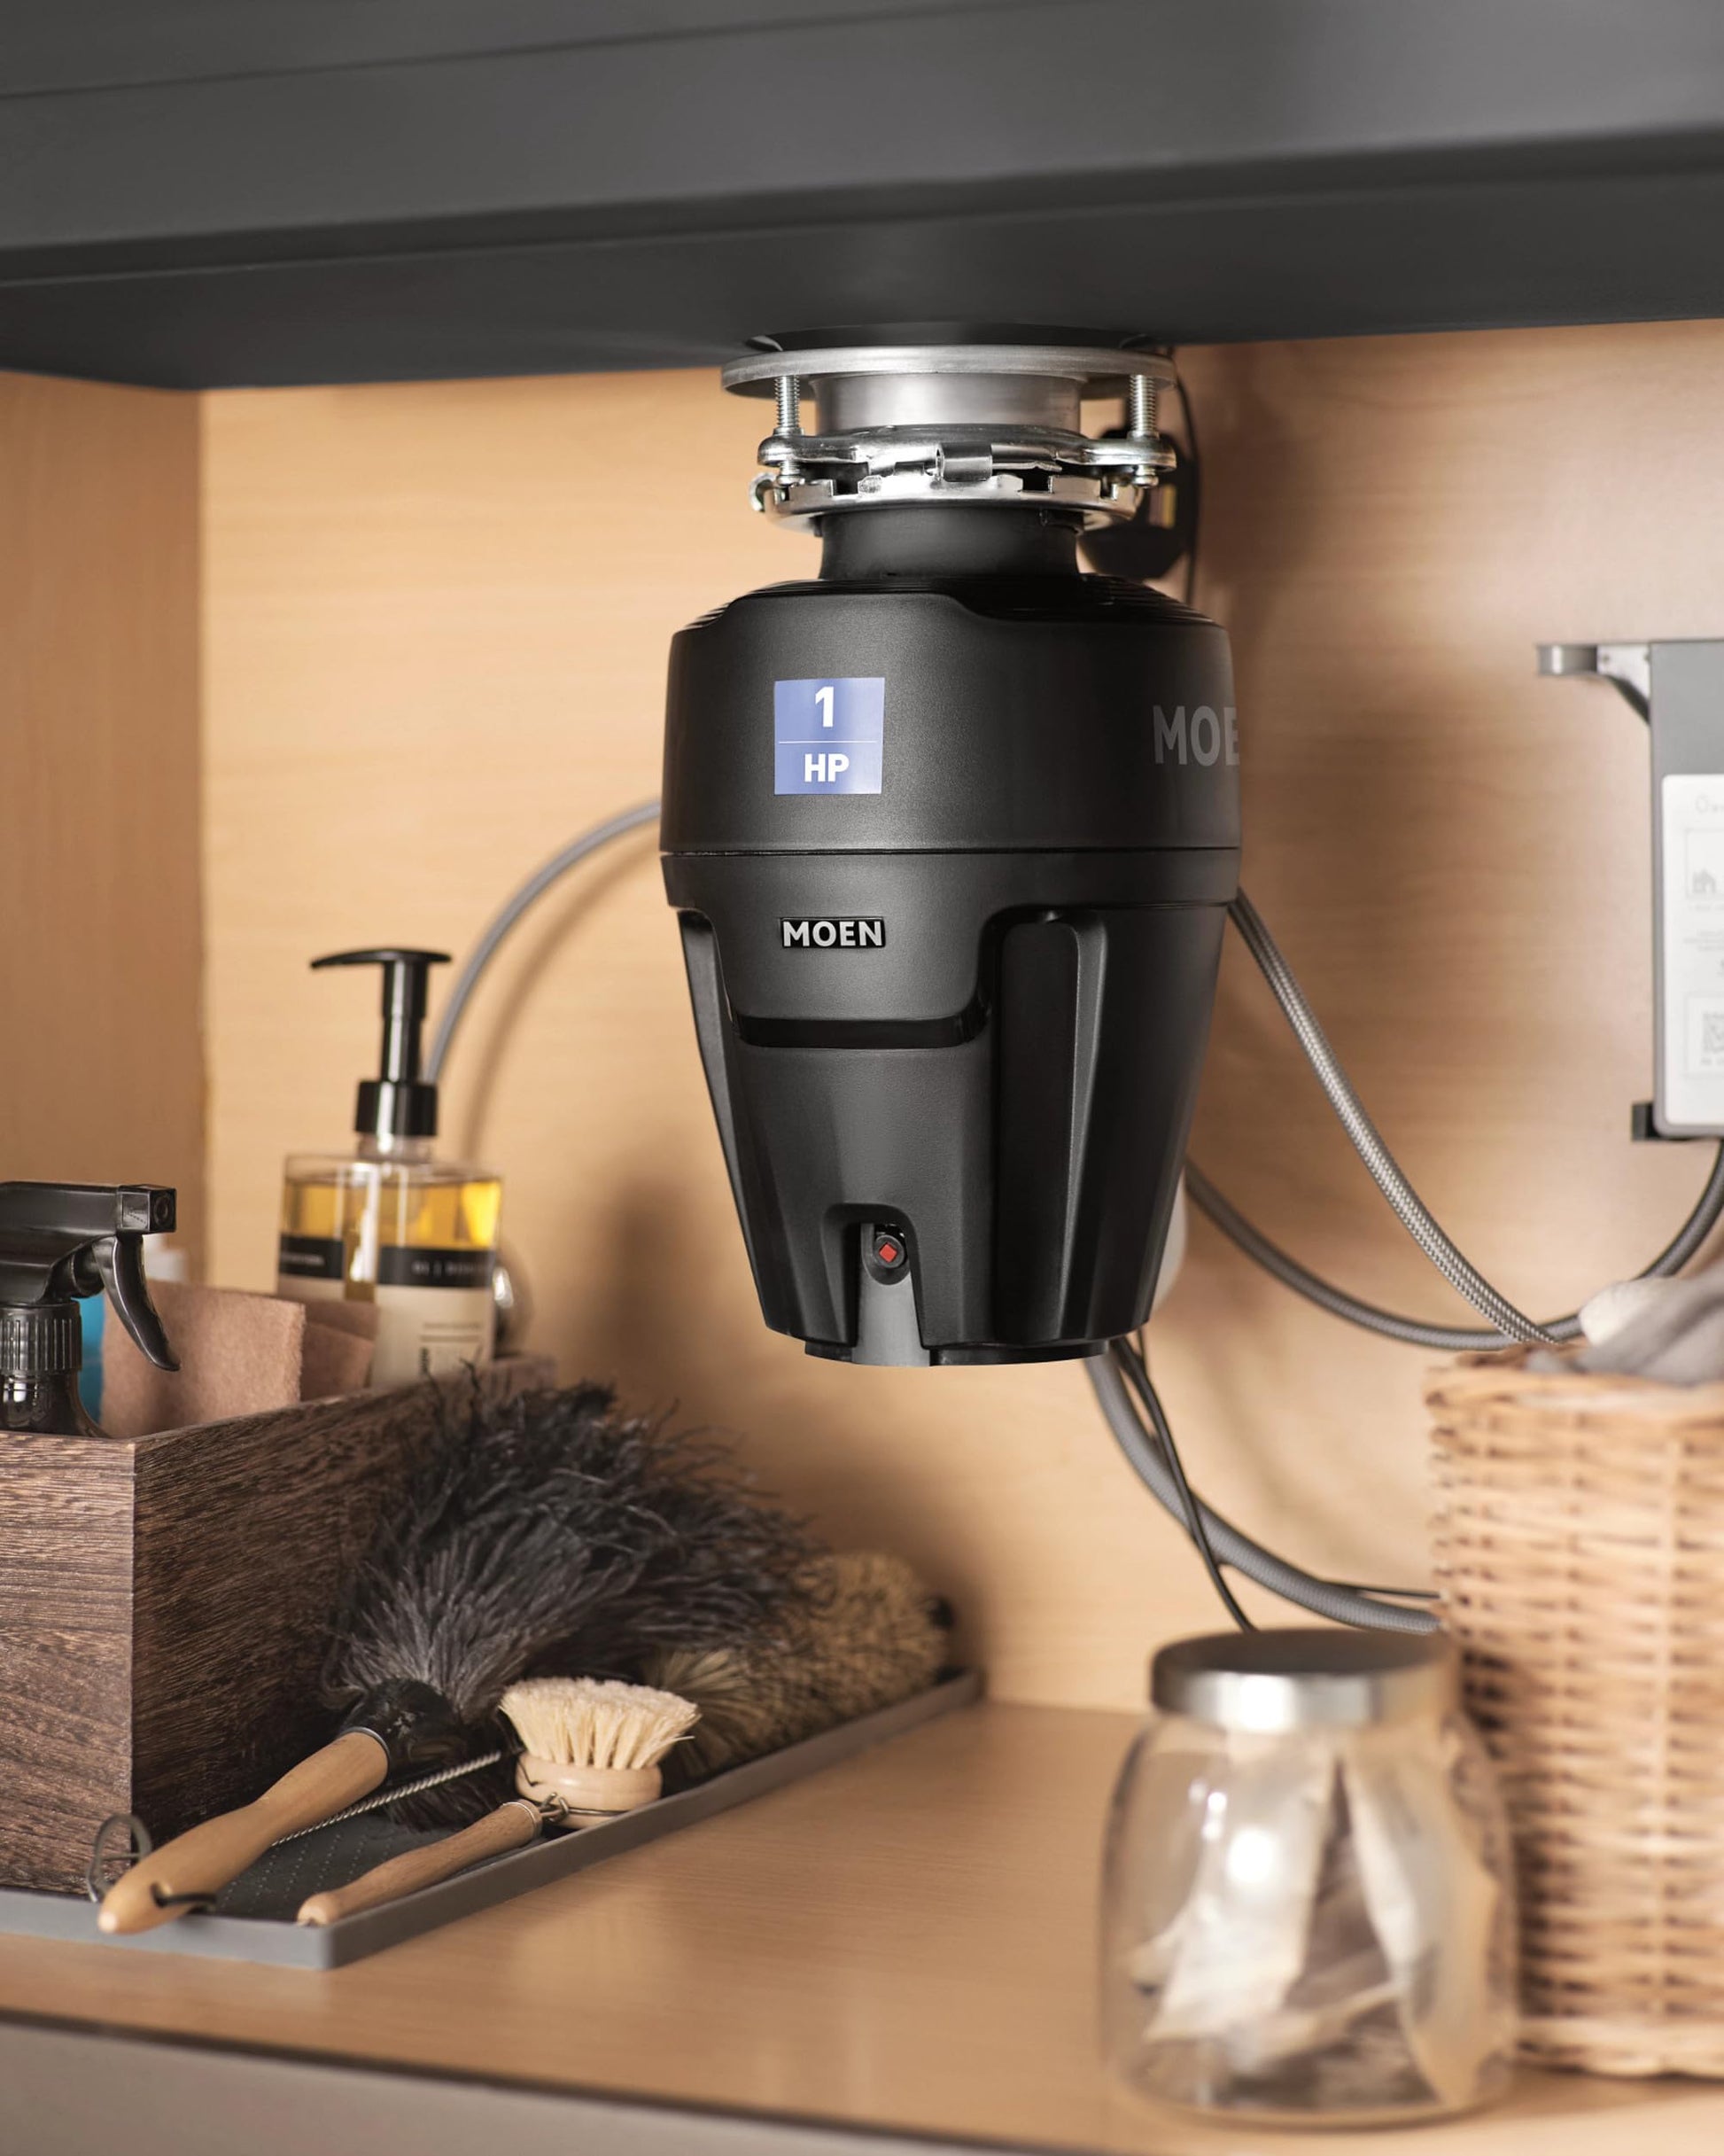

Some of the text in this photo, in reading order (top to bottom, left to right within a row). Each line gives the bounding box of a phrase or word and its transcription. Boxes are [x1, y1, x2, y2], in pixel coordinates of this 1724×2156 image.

[815, 686, 835, 728] 1
[804, 753, 850, 782] HP
[782, 921, 883, 947] MOEN
